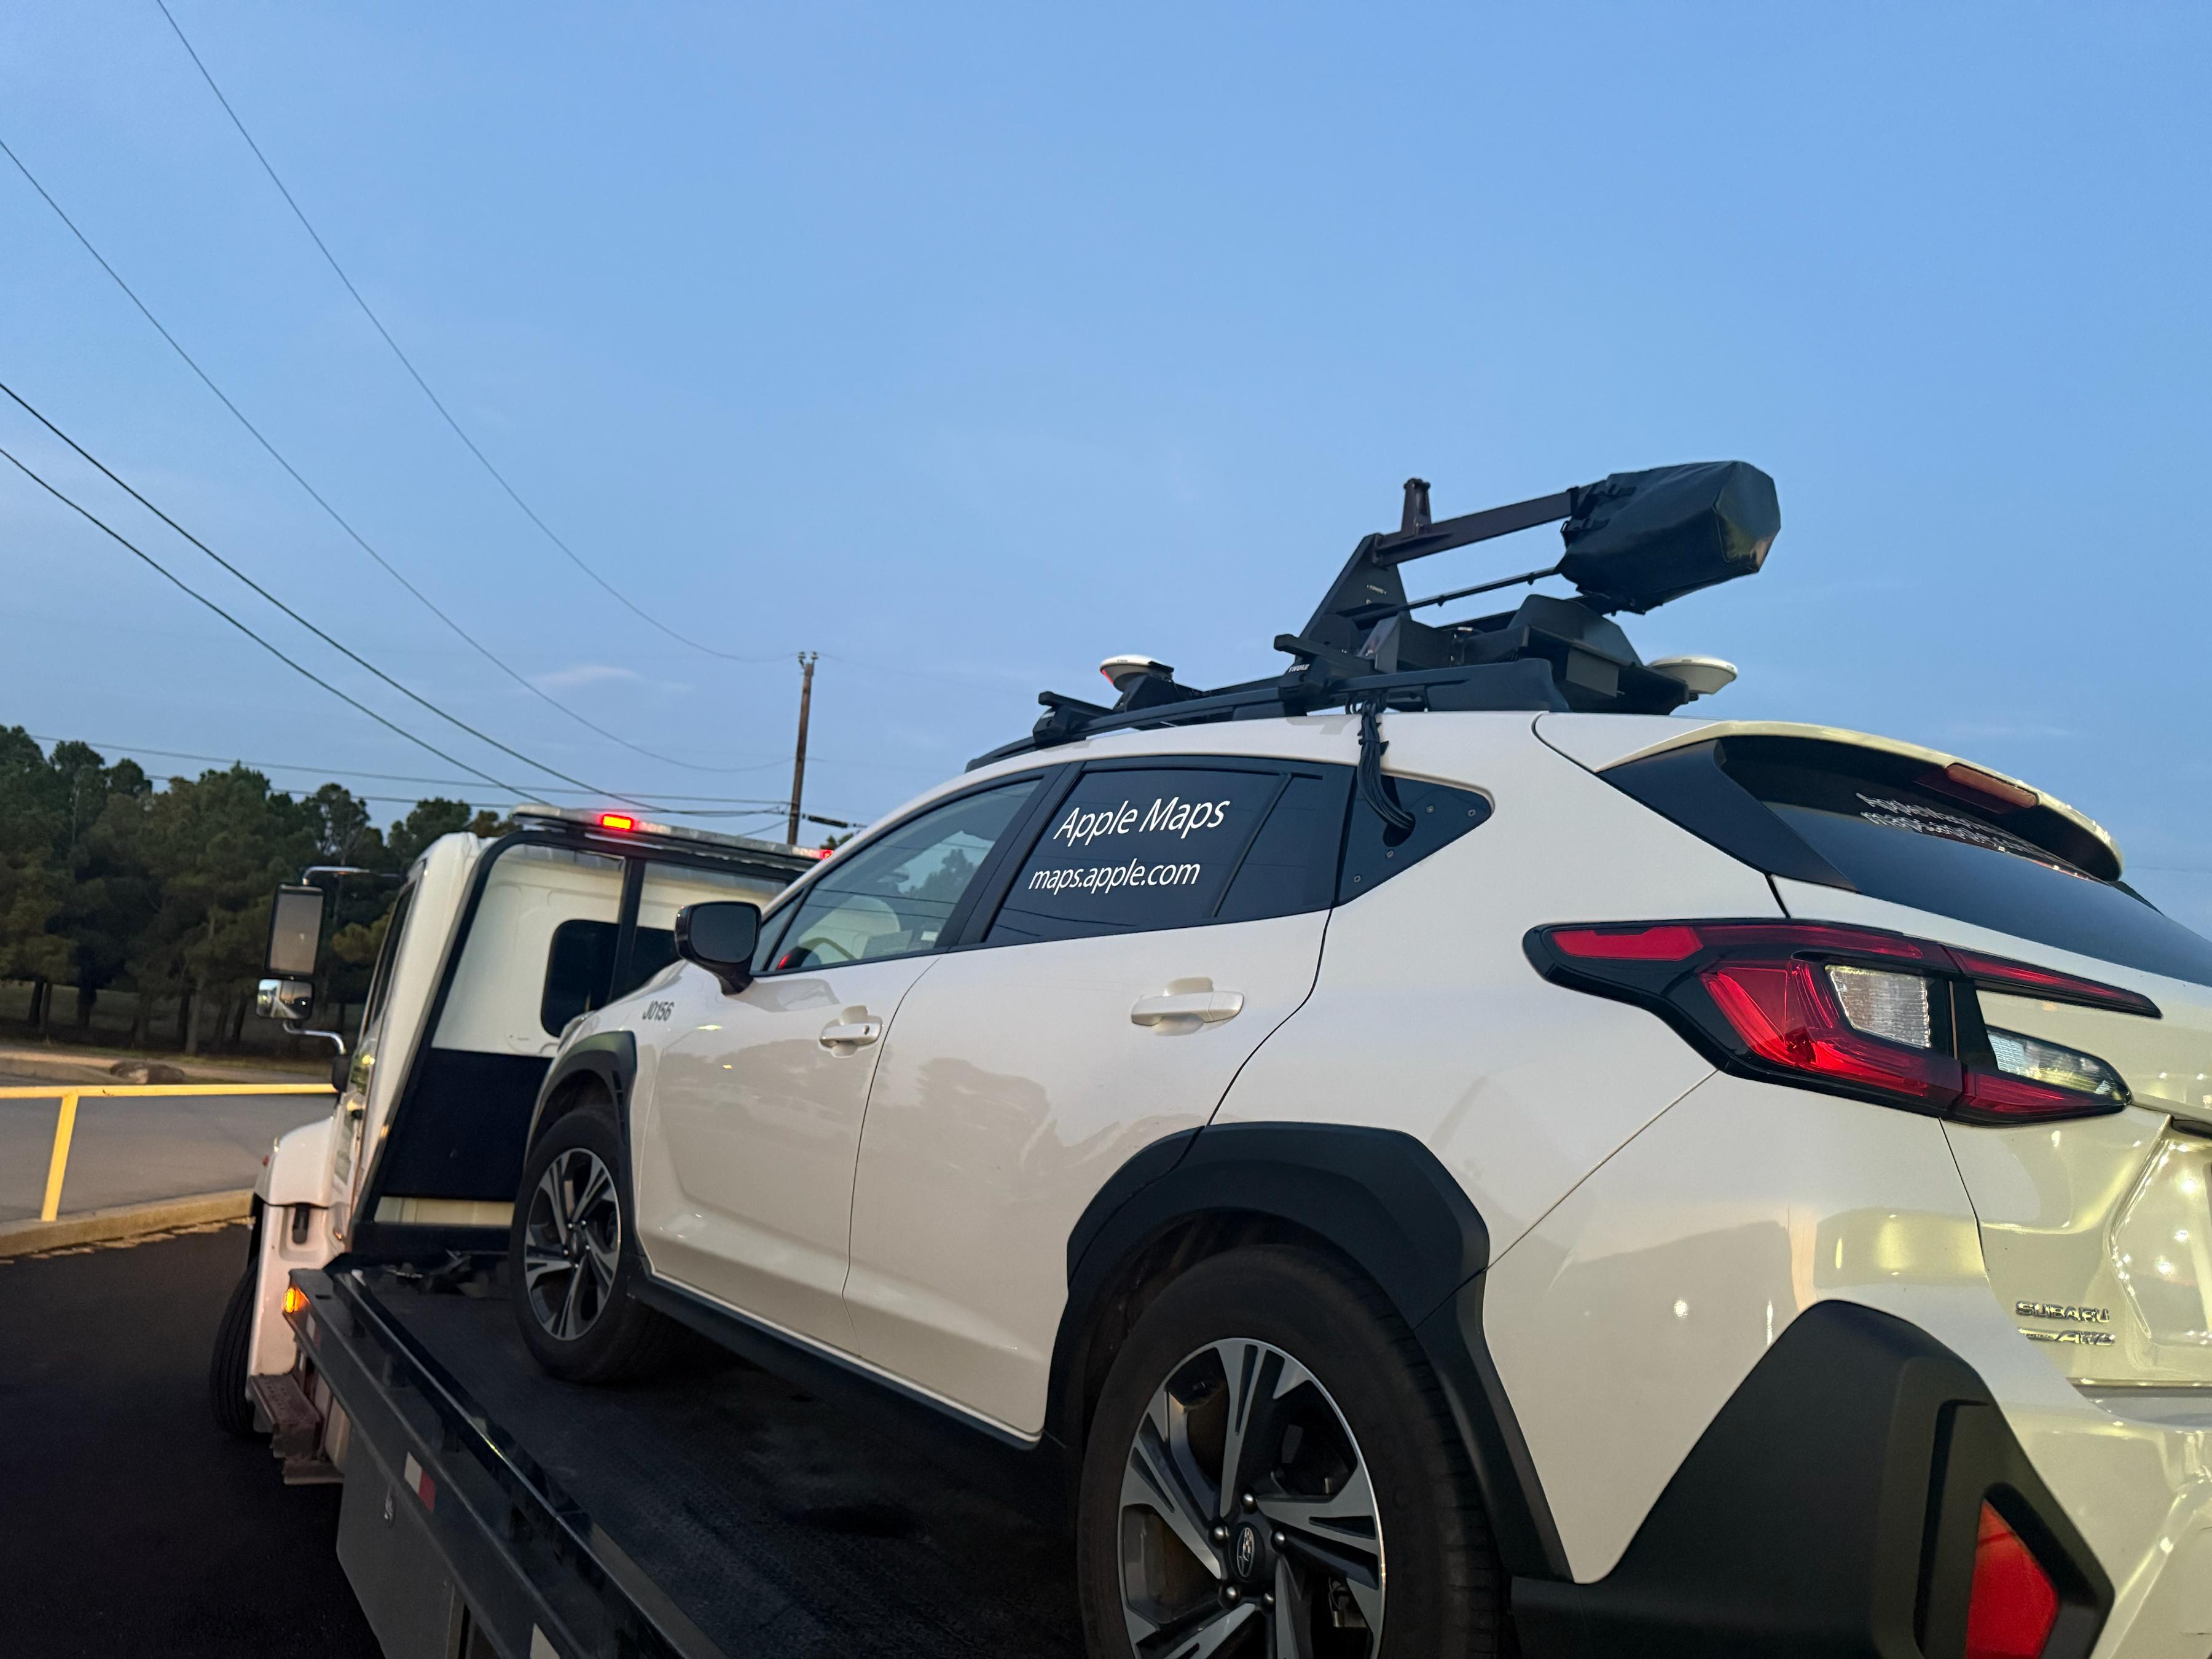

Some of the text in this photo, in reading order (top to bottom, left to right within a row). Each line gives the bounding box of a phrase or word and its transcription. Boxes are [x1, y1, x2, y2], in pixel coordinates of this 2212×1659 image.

[1053, 796, 1230, 847] Apple Maps
[1029, 858, 1201, 895] maps.apple.com
[2015, 1300, 2109, 1323] SUBARU
